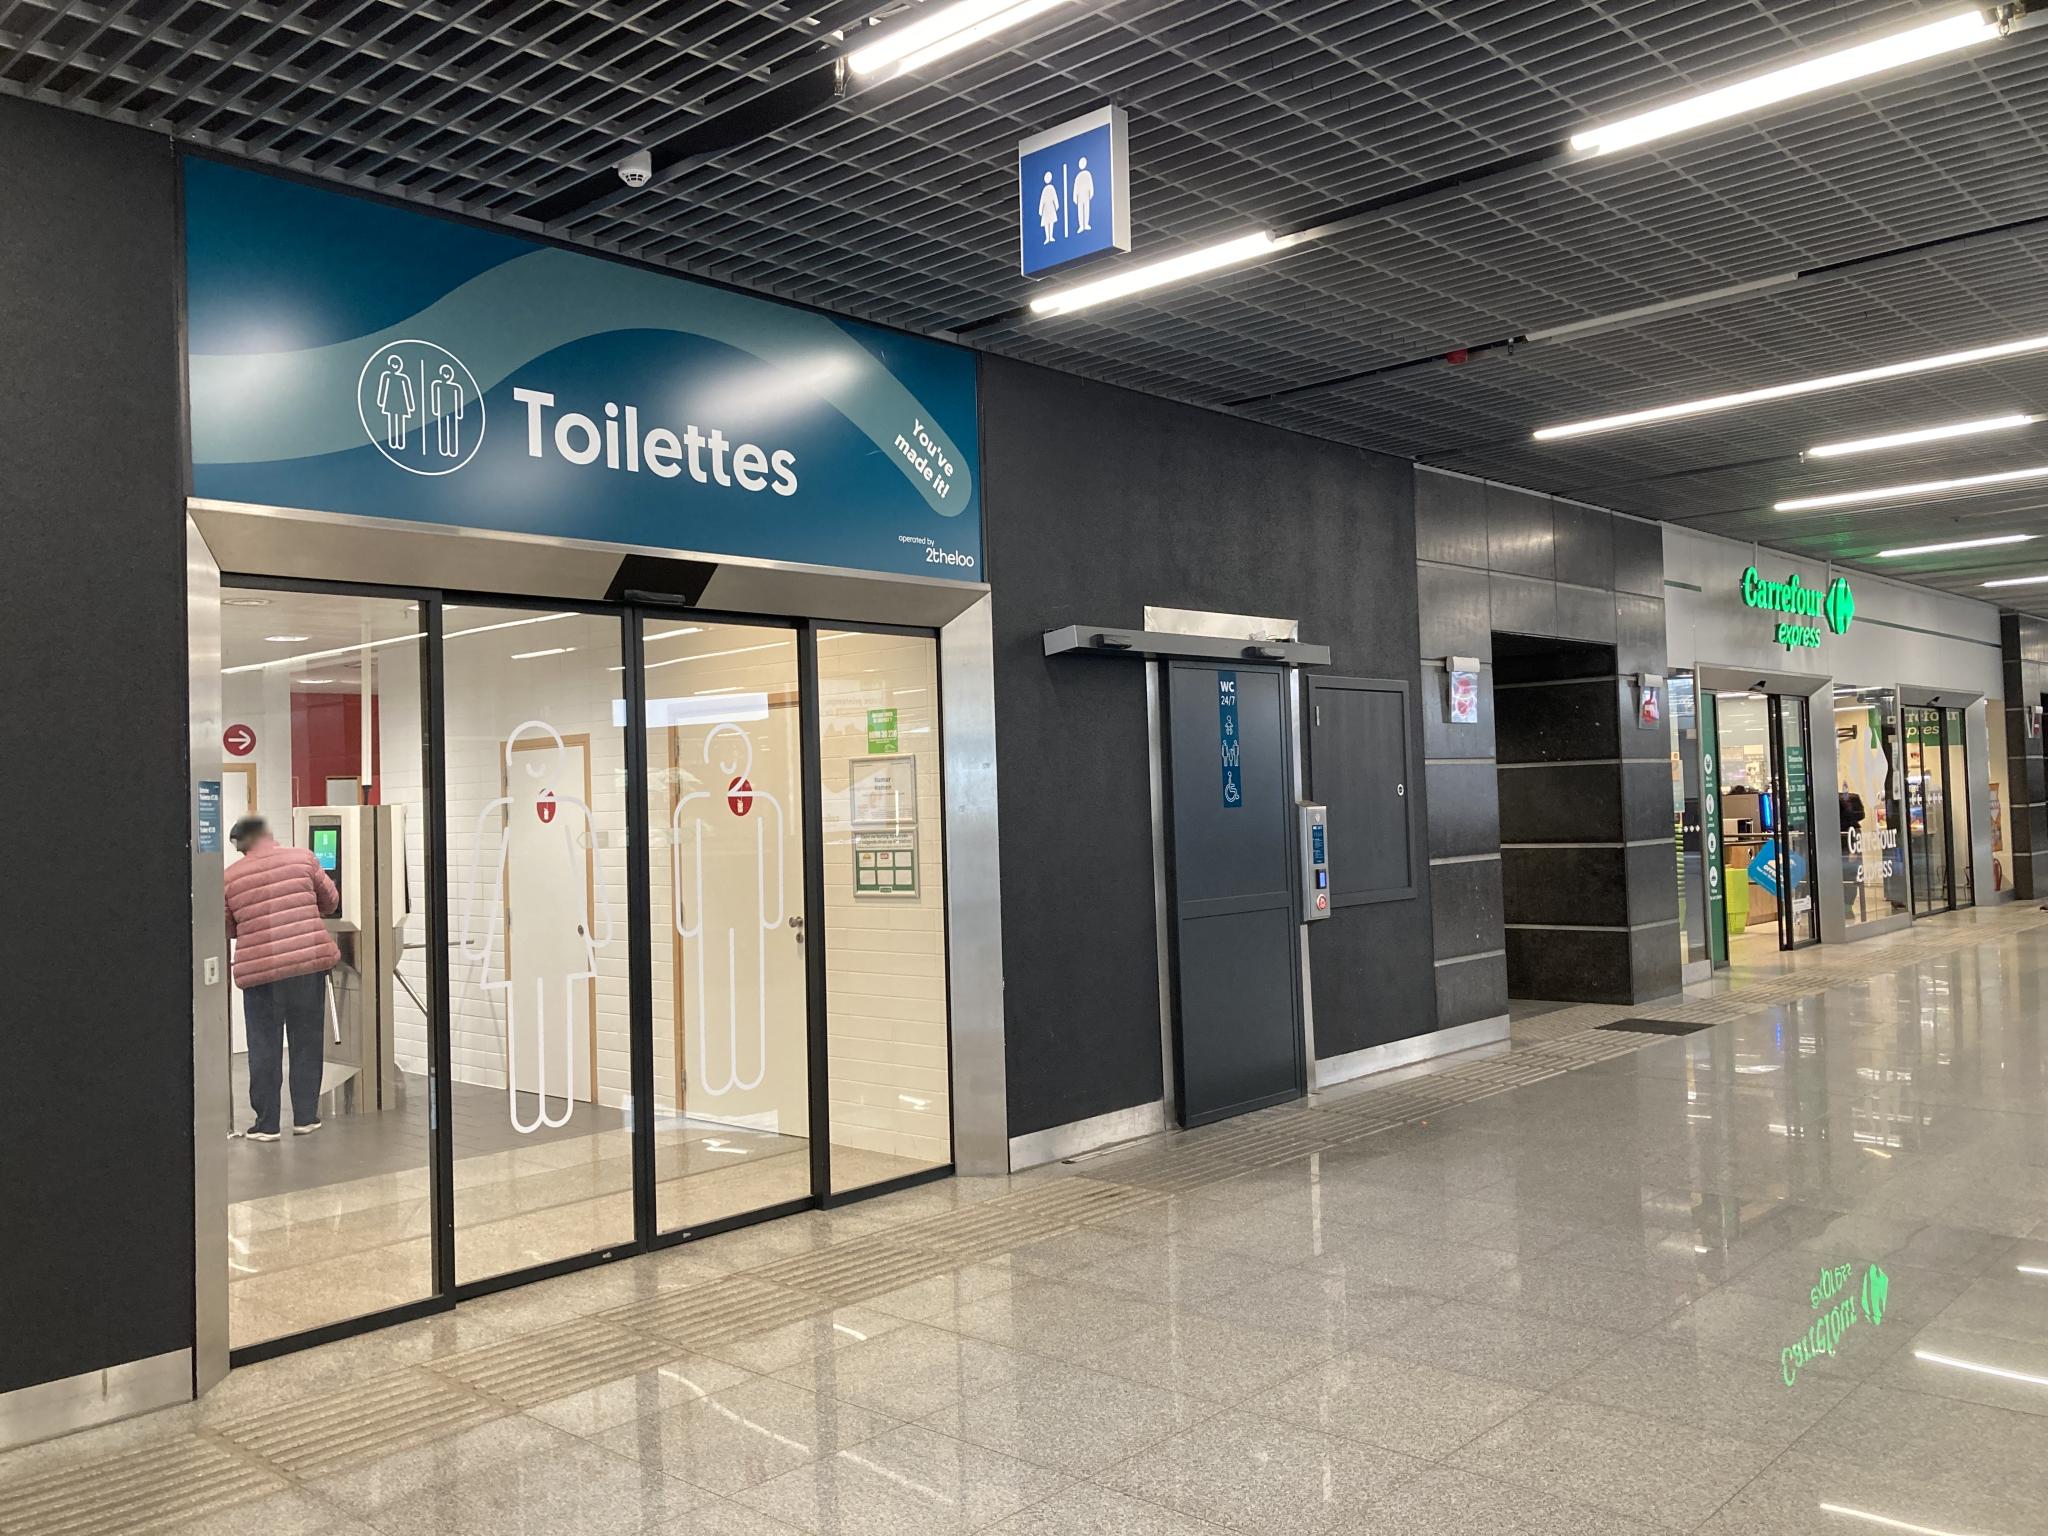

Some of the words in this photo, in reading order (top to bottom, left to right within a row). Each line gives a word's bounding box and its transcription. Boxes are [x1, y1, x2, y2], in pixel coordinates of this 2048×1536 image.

[513, 387, 798, 497] Toilettes
[912, 418, 954, 477] You've
[894, 434, 934, 481] made
[932, 474, 950, 499] it!
[898, 534, 926, 546] operated
[927, 537, 935, 547] by
[925, 547, 975, 568] 2theloo
[1743, 566, 1823, 618] Carrefour
[1777, 622, 1821, 652] express
[1219, 680, 1235, 693] WC
[1220, 695, 1236, 706] 24/7
